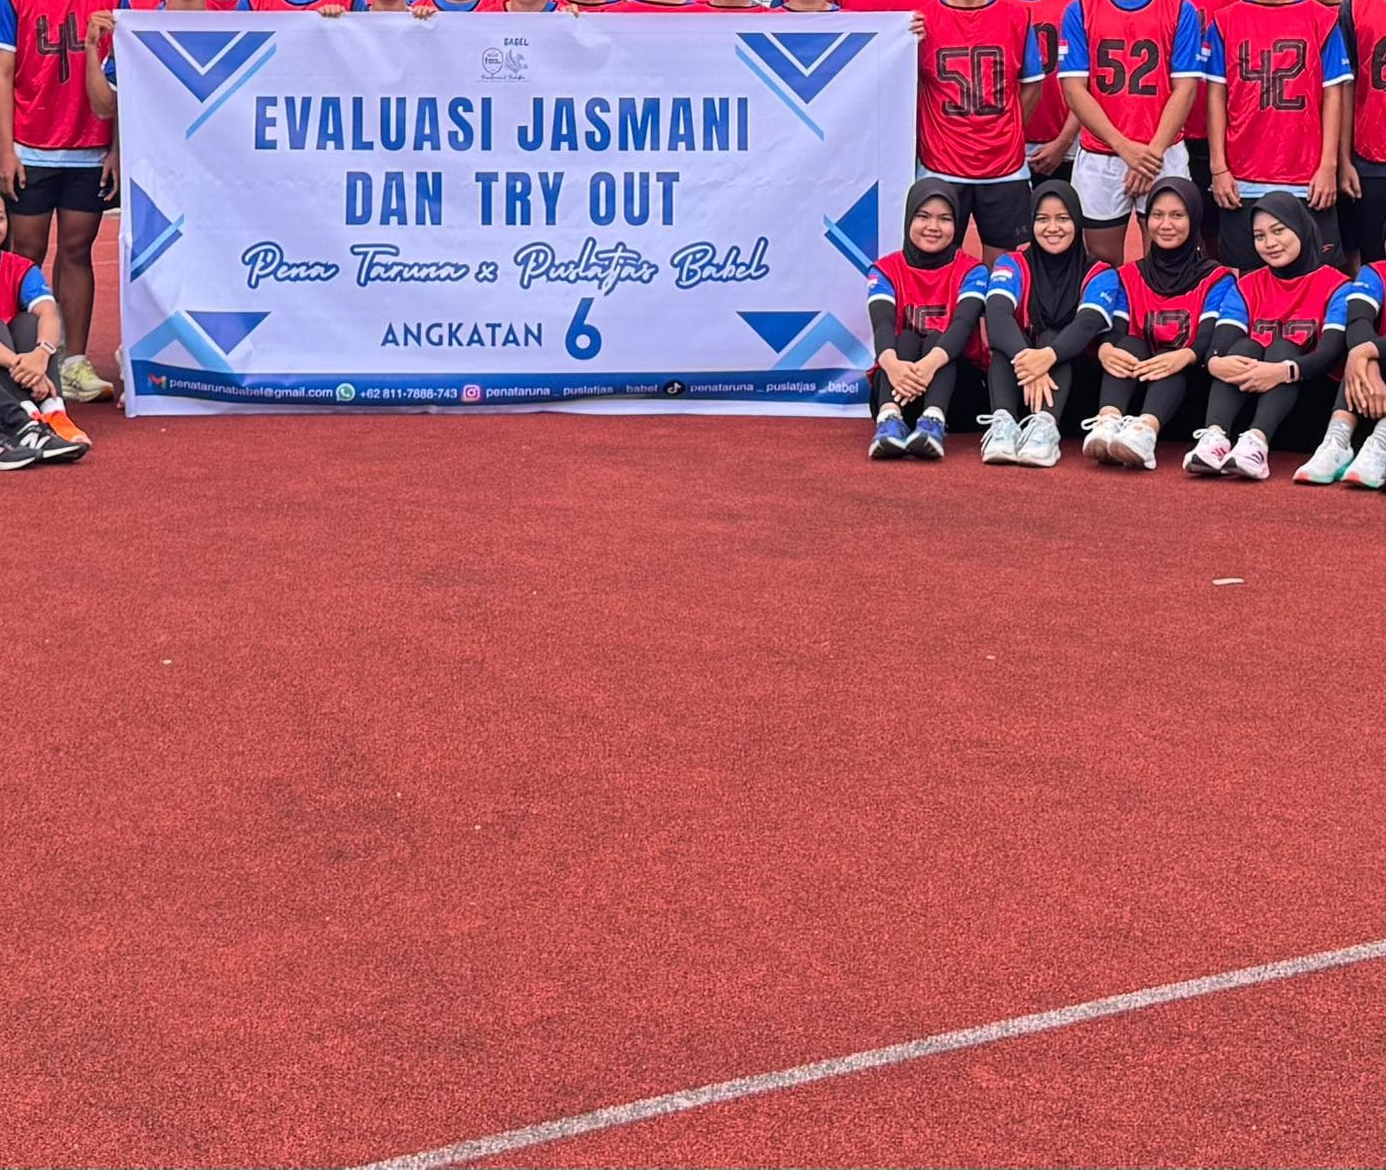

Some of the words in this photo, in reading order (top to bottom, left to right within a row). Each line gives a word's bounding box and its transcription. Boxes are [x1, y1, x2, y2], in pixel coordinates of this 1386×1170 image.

[935, 44, 1006, 117] 50
[1096, 38, 1160, 97] 52
[1237, 37, 1308, 112] 42
[253, 95, 494, 152] EVALUASI
[516, 96, 749, 152] JASMANI
[345, 171, 443, 226] DAN
[474, 171, 566, 226] TRY
[588, 171, 680, 226] OUT
[241, 240, 340, 290] Pena
[349, 243, 470, 288] Taruna
[474, 260, 499, 284] x
[513, 236, 660, 297] Puslatjas
[669, 236, 770, 290] Babel
[380, 322, 543, 348] ANGKATAN
[564, 296, 603, 362] 6
[169, 376, 333, 399] penatarunababel@gmail.com
[486, 387, 551, 398] penataruna
[689, 382, 754, 394] penataruna
